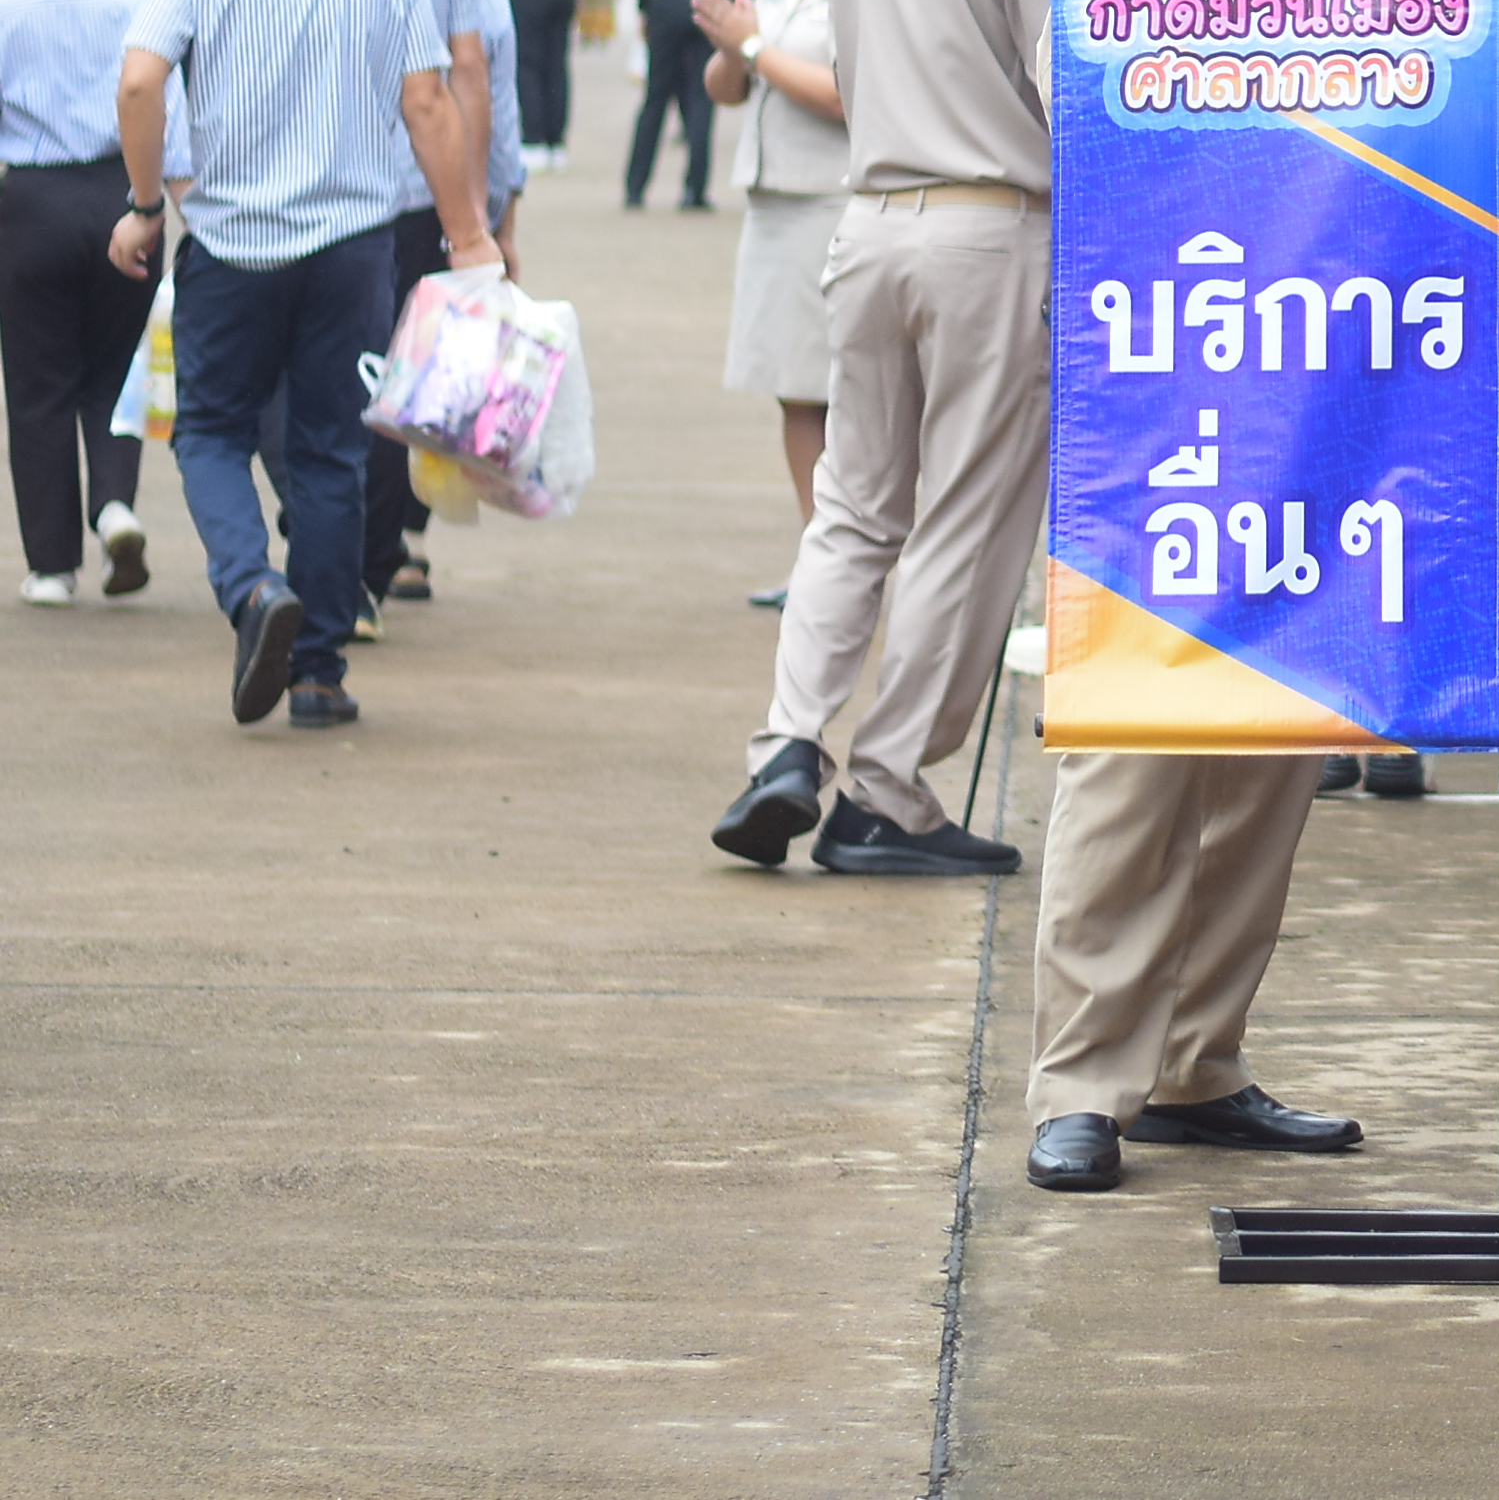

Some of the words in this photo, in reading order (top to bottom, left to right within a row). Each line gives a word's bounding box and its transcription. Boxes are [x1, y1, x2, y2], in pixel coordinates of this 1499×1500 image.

[1121, 47, 1436, 112] ศาลากลาง
[1090, 231, 1465, 373] บริการ
